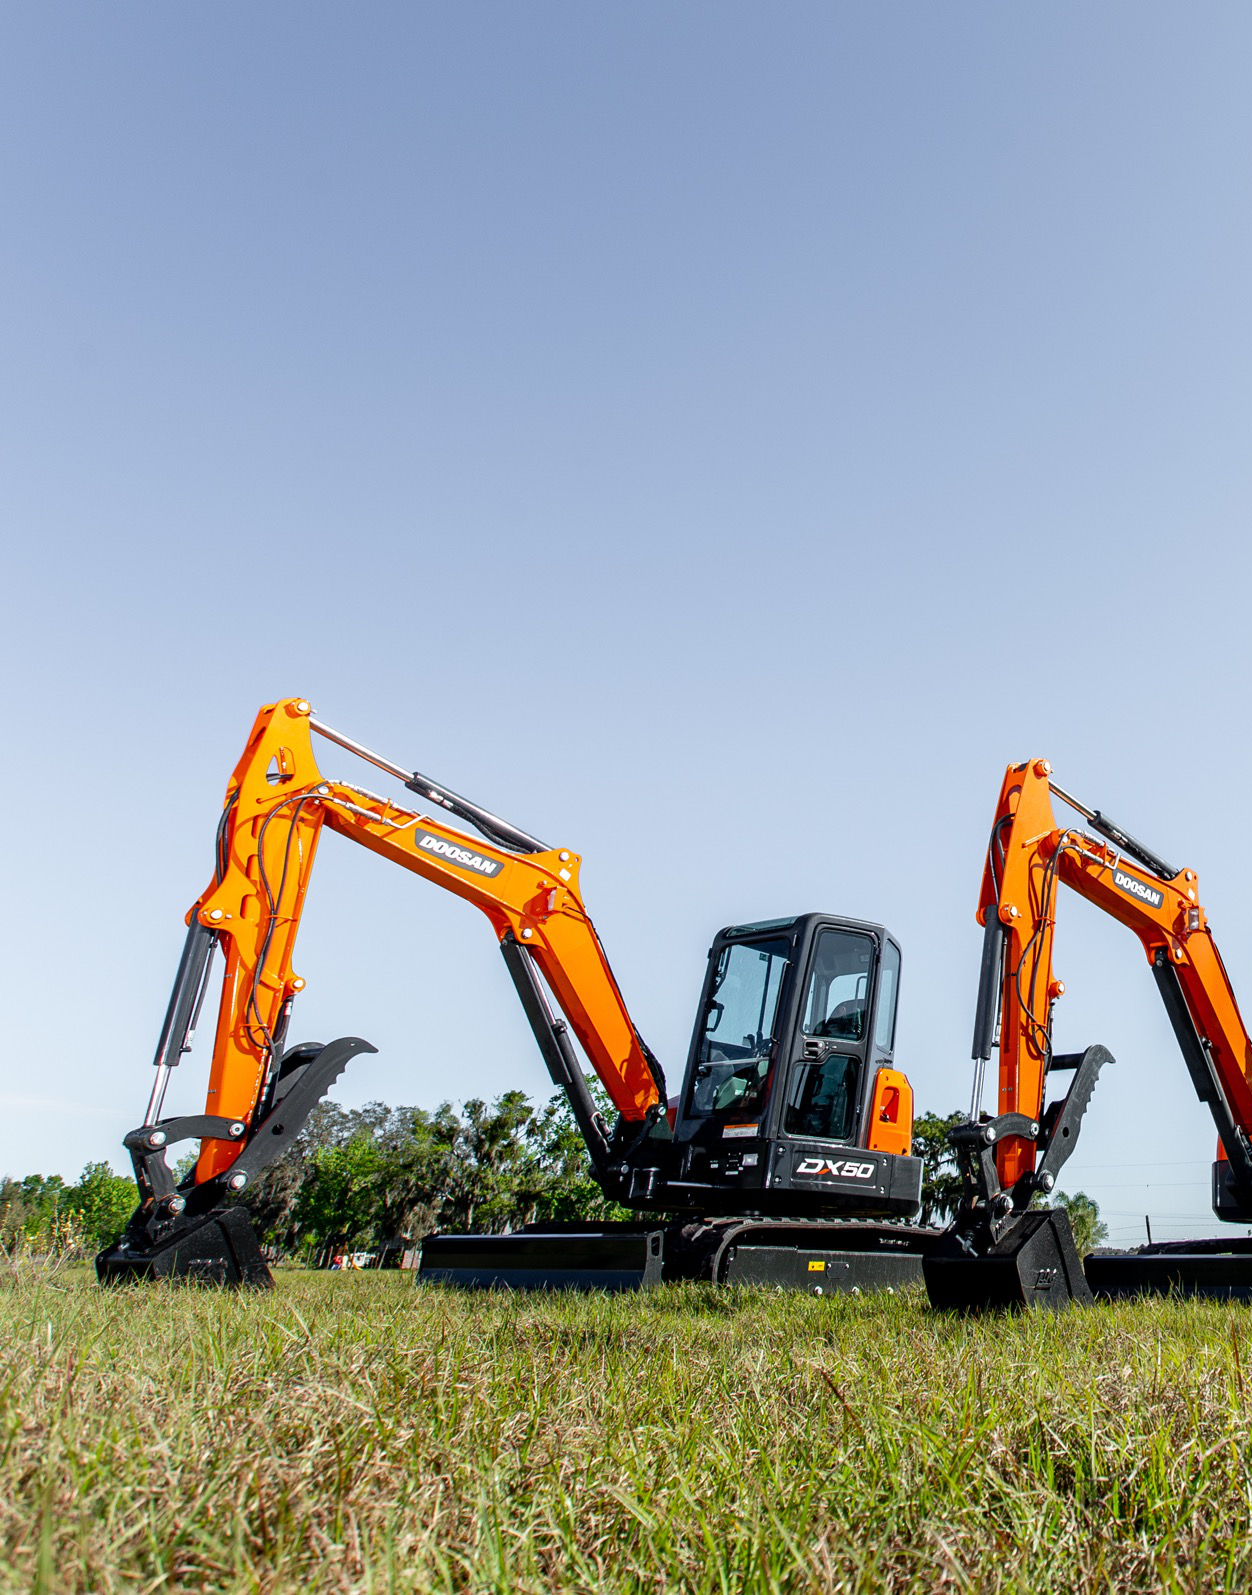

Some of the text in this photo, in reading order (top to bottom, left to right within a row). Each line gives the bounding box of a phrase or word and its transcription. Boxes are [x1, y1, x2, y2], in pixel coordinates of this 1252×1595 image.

[419, 835, 497, 874] DOOSAN
[1115, 872, 1160, 904] DOOSAN
[796, 1158, 875, 1178] DX50
